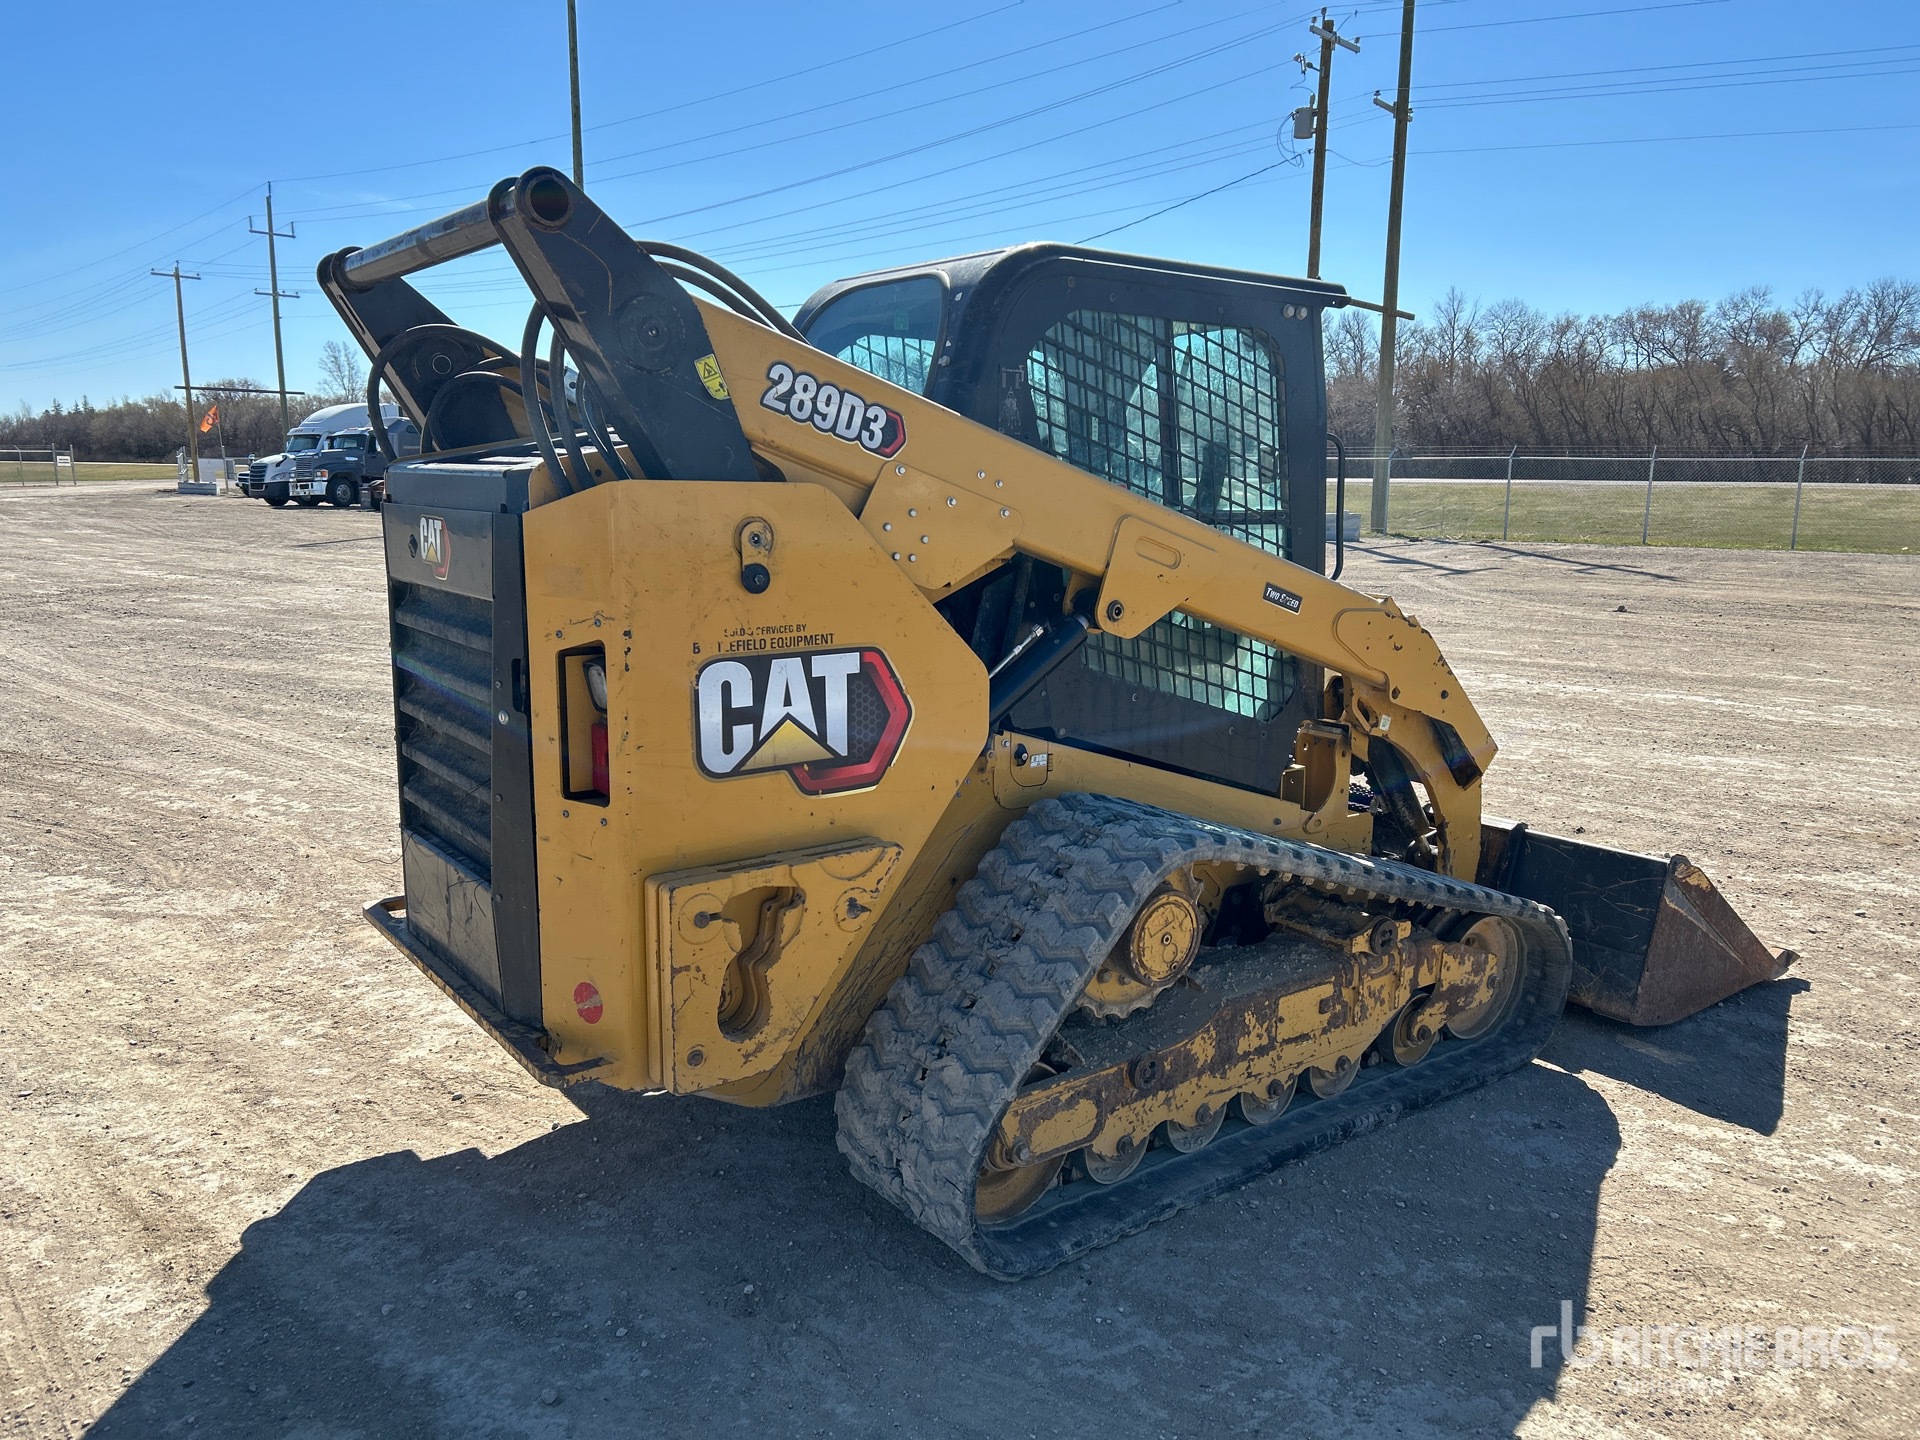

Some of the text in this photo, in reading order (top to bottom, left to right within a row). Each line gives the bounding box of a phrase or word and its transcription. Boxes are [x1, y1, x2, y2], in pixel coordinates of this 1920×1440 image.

[763, 364, 887, 449] 289D3
[420, 517, 442, 563] CAT
[770, 632, 835, 650] EQUIPMENT
[796, 623, 807, 633] BY
[698, 651, 861, 775] CAT
